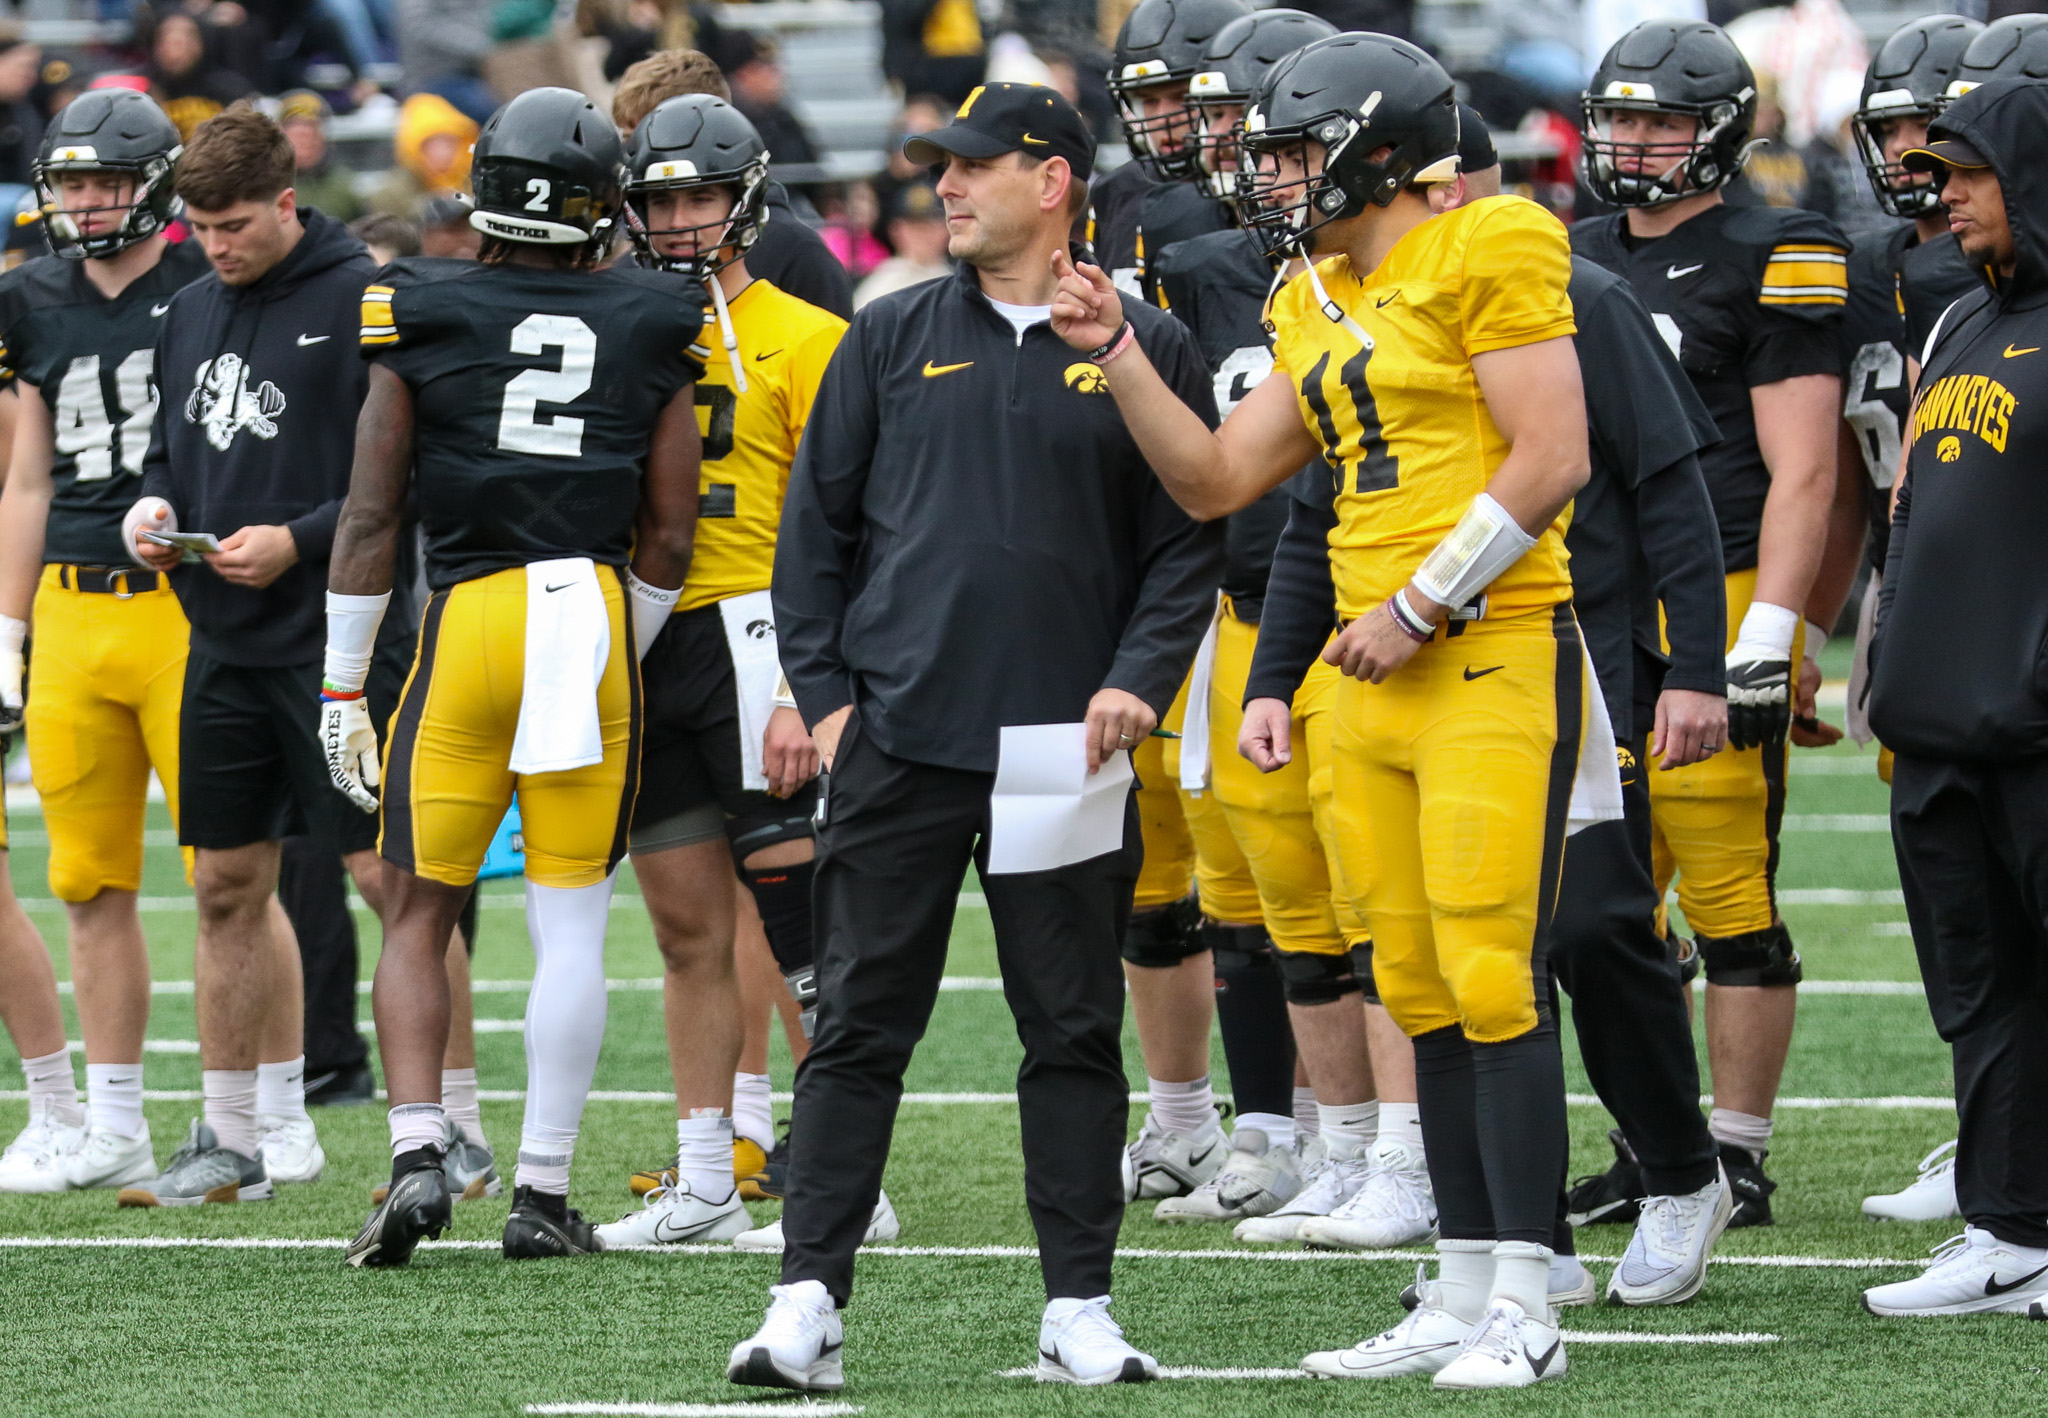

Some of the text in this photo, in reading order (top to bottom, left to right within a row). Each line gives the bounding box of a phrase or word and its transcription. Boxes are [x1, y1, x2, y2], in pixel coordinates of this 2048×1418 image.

[524, 178, 551, 212] 2
[486, 219, 551, 239] TOGETHER
[498, 313, 597, 457] 2
[1302, 346, 1399, 495] 11
[638, 586, 669, 602] PRO
[328, 710, 355, 793] HAWKEYES
